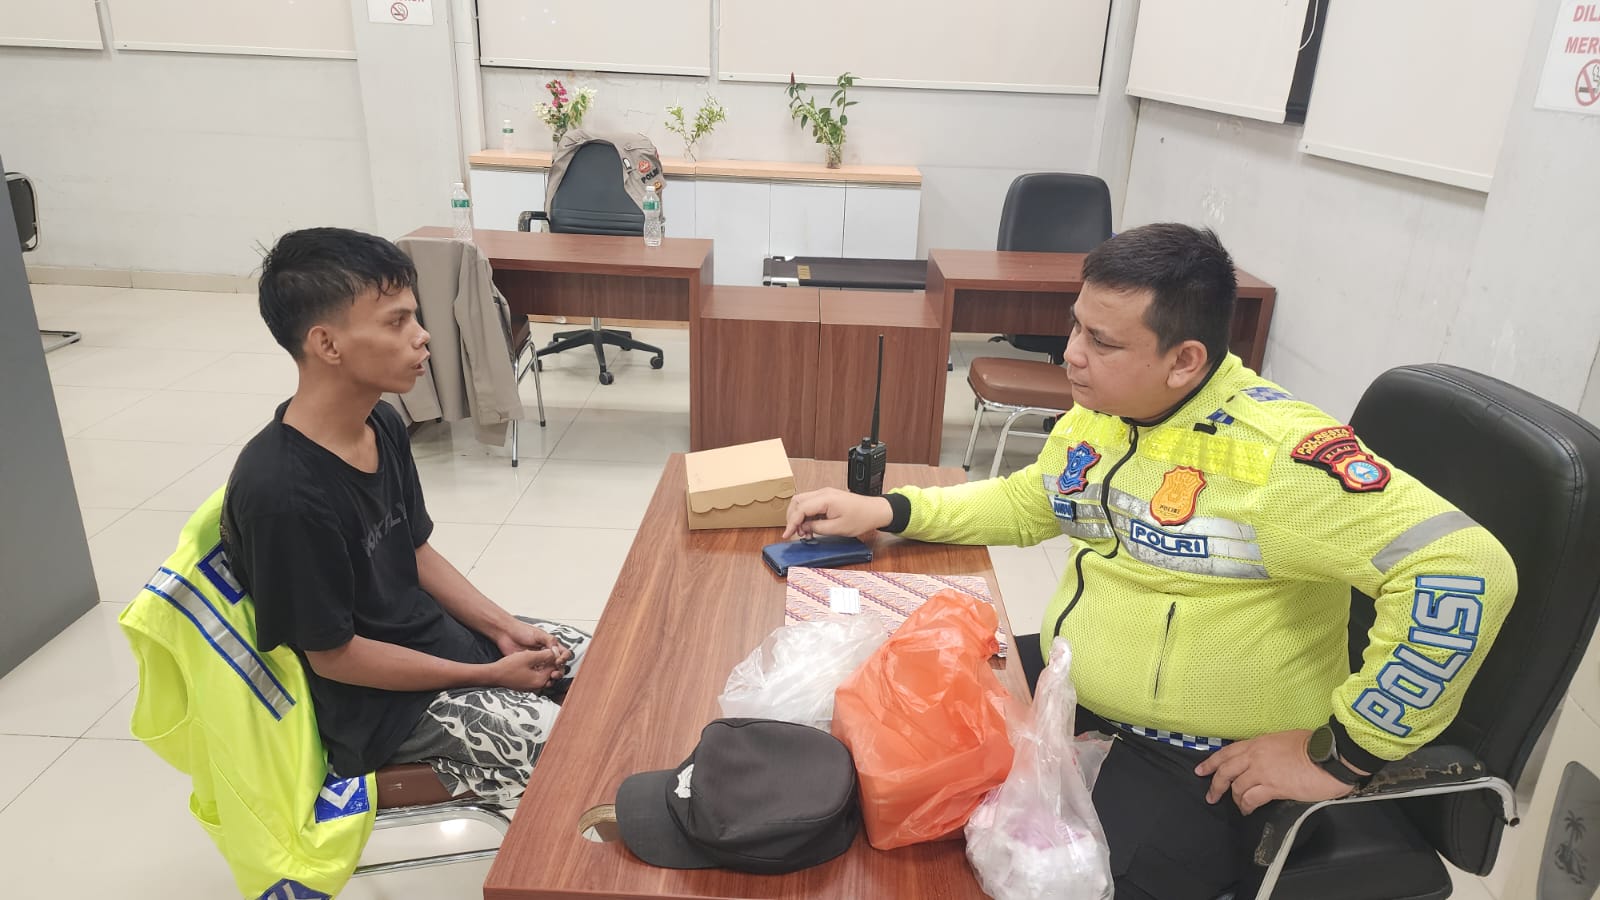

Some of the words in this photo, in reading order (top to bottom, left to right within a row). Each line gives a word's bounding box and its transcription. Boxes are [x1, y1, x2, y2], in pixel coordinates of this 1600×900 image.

[1573, 5, 1600, 22] DIL
[1564, 37, 1600, 54] MER
[1297, 428, 1350, 455] POLRESTA
[1135, 527, 1202, 553] POLRI
[1351, 574, 1485, 738] POLISI
